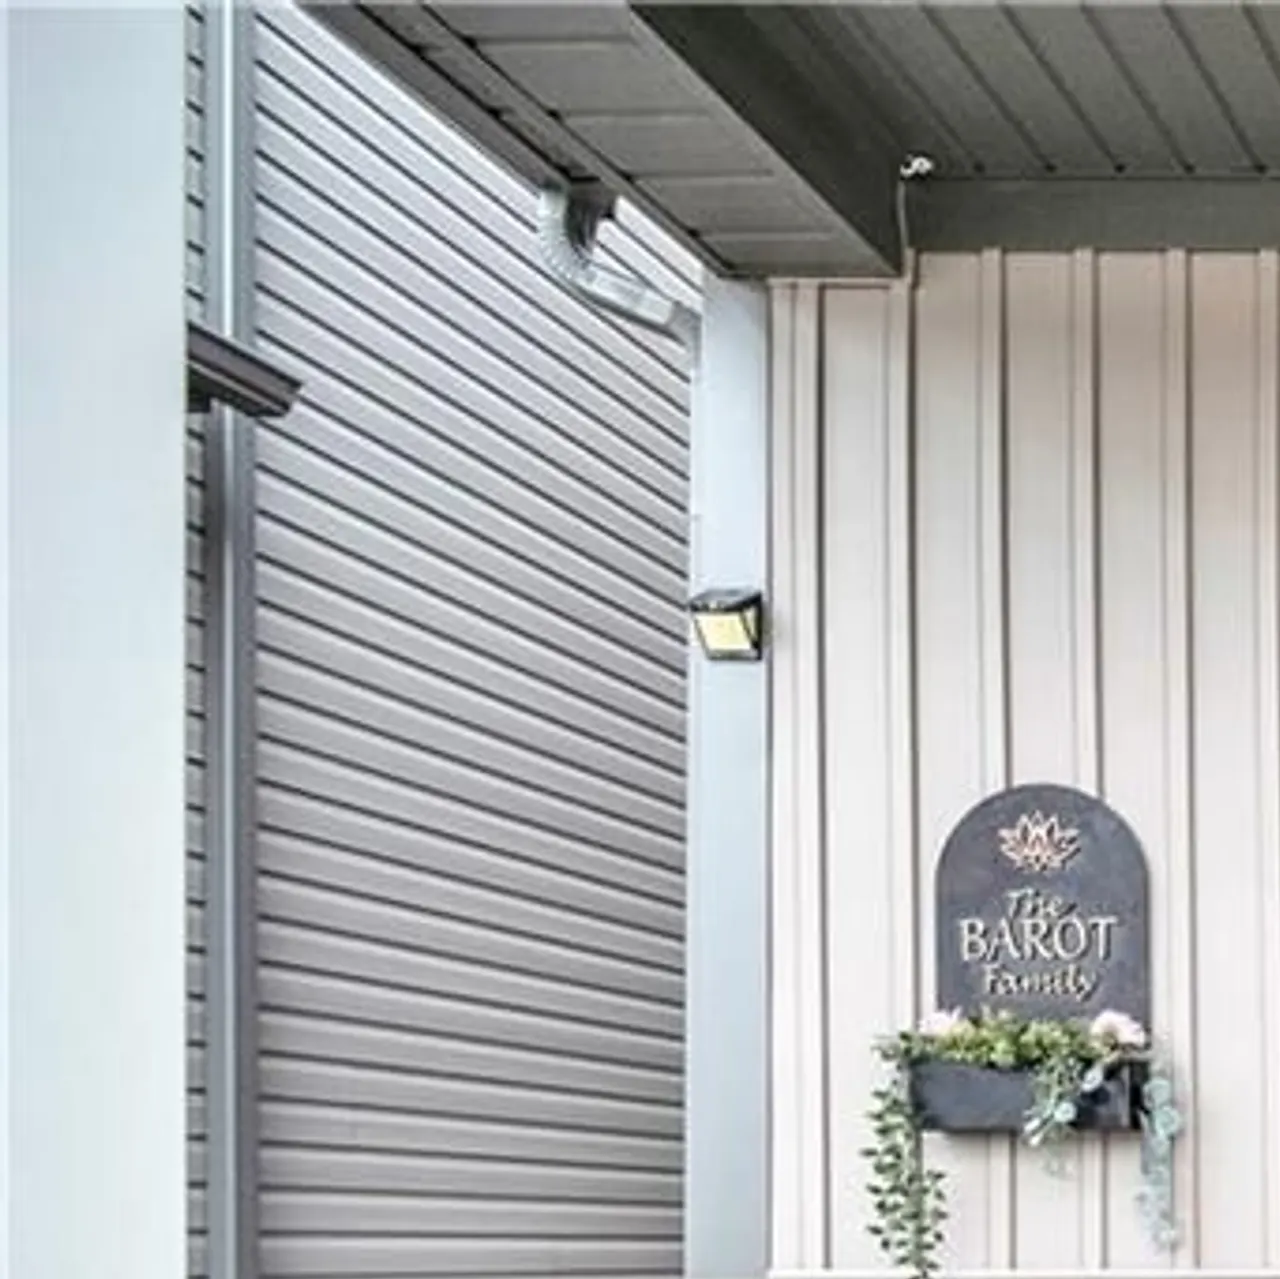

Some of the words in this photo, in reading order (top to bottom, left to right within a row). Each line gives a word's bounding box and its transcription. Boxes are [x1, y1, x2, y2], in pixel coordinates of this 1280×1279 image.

[1005, 887, 1072, 917] The
[959, 914, 1118, 961] BAROT
[984, 963, 1097, 1001] Family
